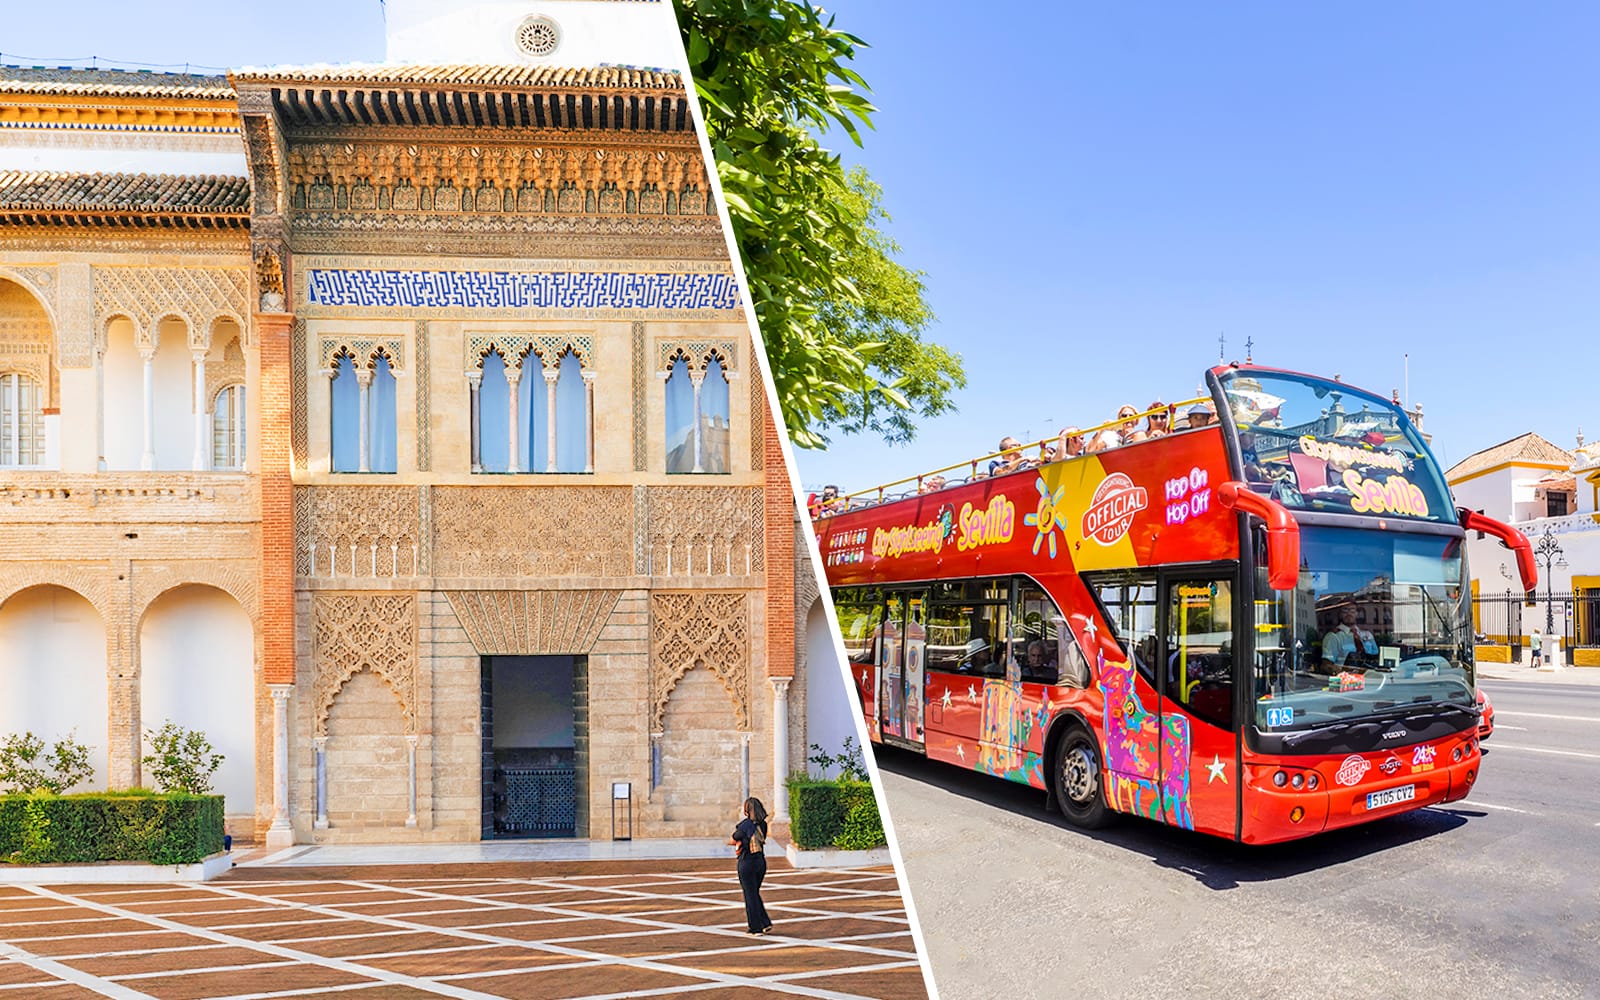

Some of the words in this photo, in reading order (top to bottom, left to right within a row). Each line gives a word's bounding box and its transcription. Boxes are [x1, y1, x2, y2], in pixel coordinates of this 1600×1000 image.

[1165, 476, 1188, 501] Hop
[1190, 467, 1208, 491] On
[1343, 469, 1429, 516] Sevilla
[957, 494, 1015, 551] Sevilla
[1087, 490, 1144, 532] OFFICIAL
[1166, 501, 1189, 526] Hop
[1191, 488, 1211, 517] Off
[1102, 518, 1129, 540] TOUR
[1382, 730, 1406, 739] VOLVO
[1373, 790, 1395, 806] 5105
[1396, 786, 1414, 800] CVZ
